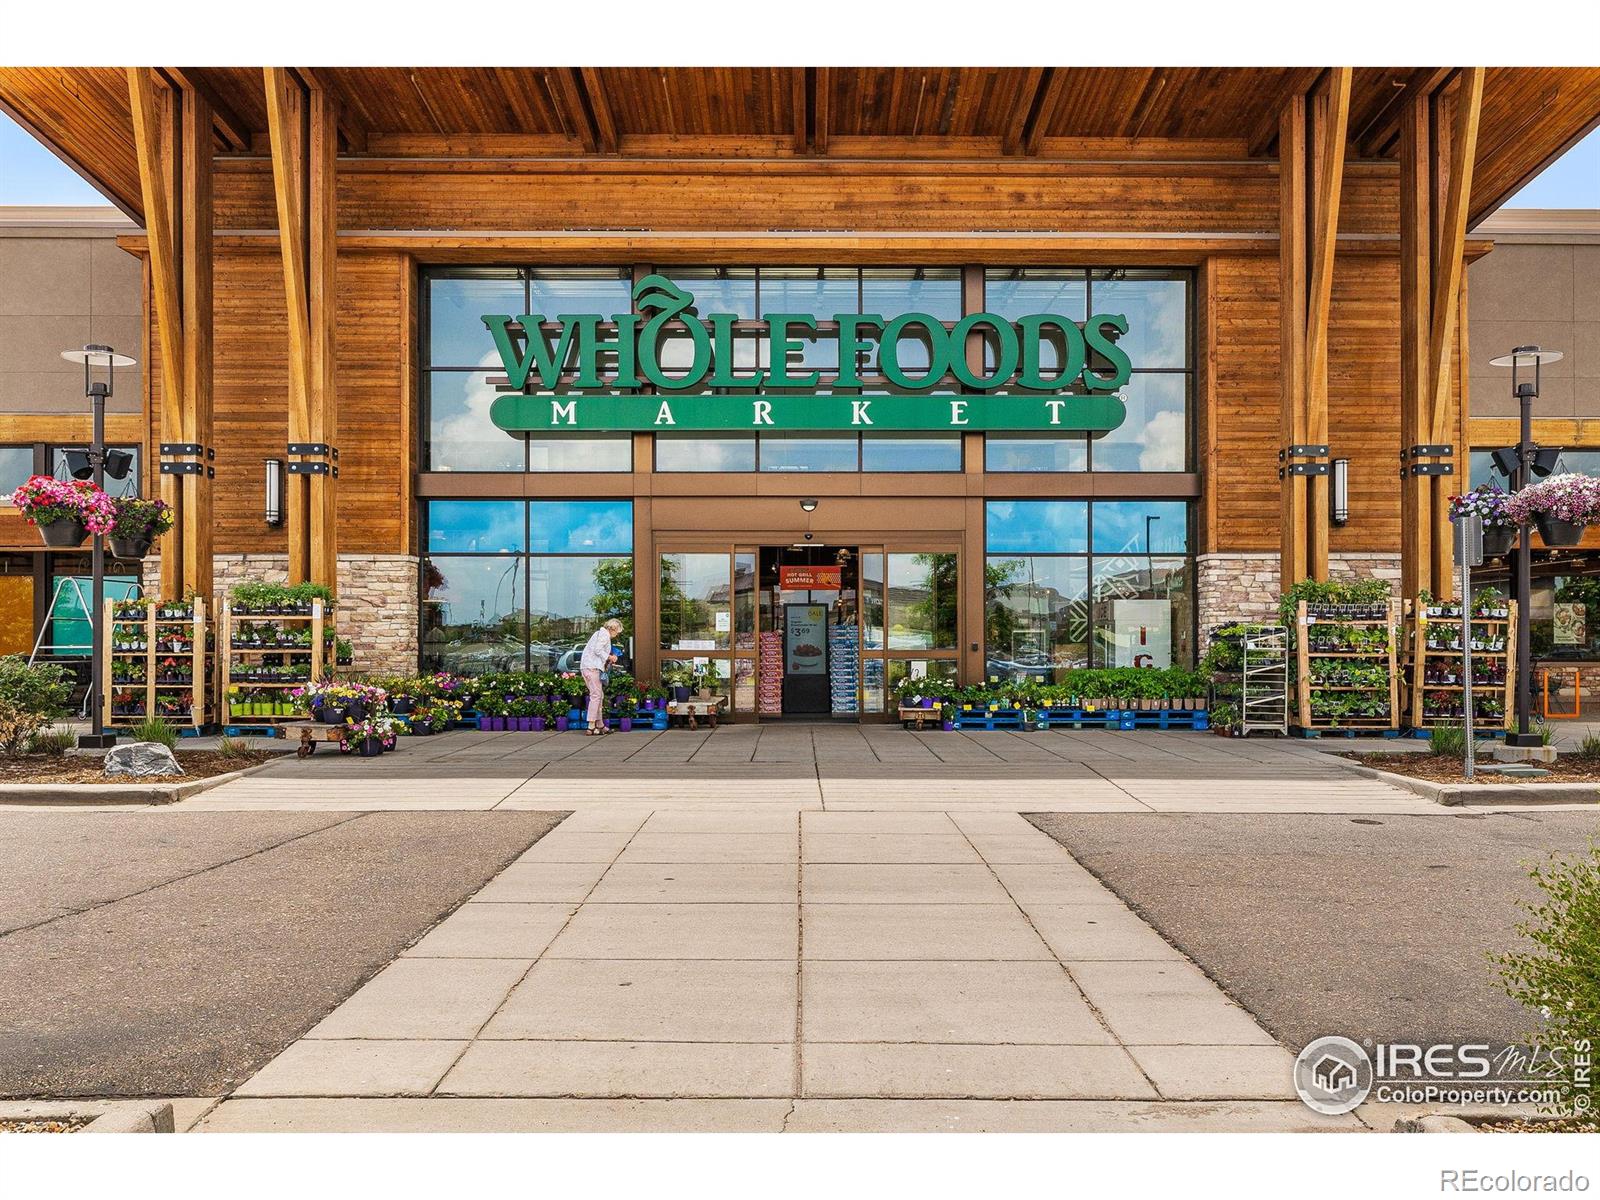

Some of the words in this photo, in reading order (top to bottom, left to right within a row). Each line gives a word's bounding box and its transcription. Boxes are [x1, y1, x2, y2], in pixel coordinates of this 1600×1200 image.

[481, 304, 820, 391] WHOLE
[833, 312, 1132, 391] FOODS
[550, 400, 1066, 426] MARKET
